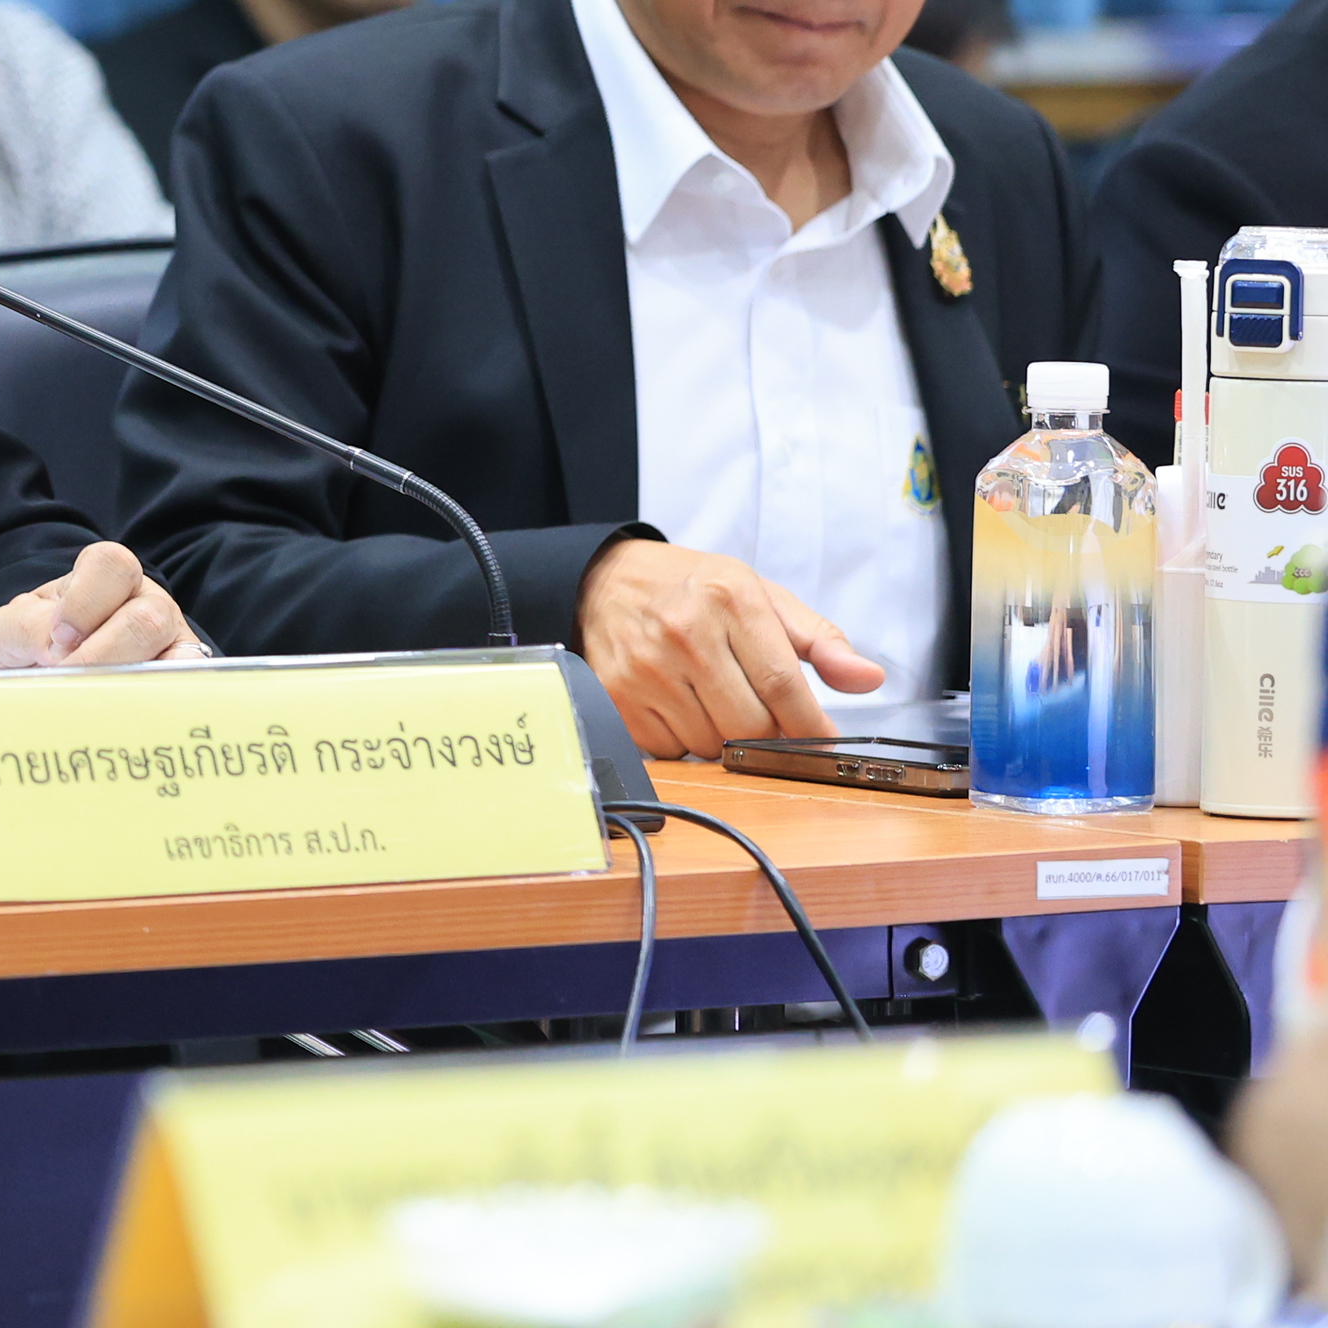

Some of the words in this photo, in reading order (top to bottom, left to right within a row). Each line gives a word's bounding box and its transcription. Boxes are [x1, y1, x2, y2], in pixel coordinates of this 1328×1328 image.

[1281, 466, 1304, 477] SUS
[1275, 478, 1308, 501] 316
[314, 712, 536, 773] กระจ่างวงษ์
[164, 822, 293, 861] เลขาธิการ
[304, 822, 388, 855] ส.ป.ก.
